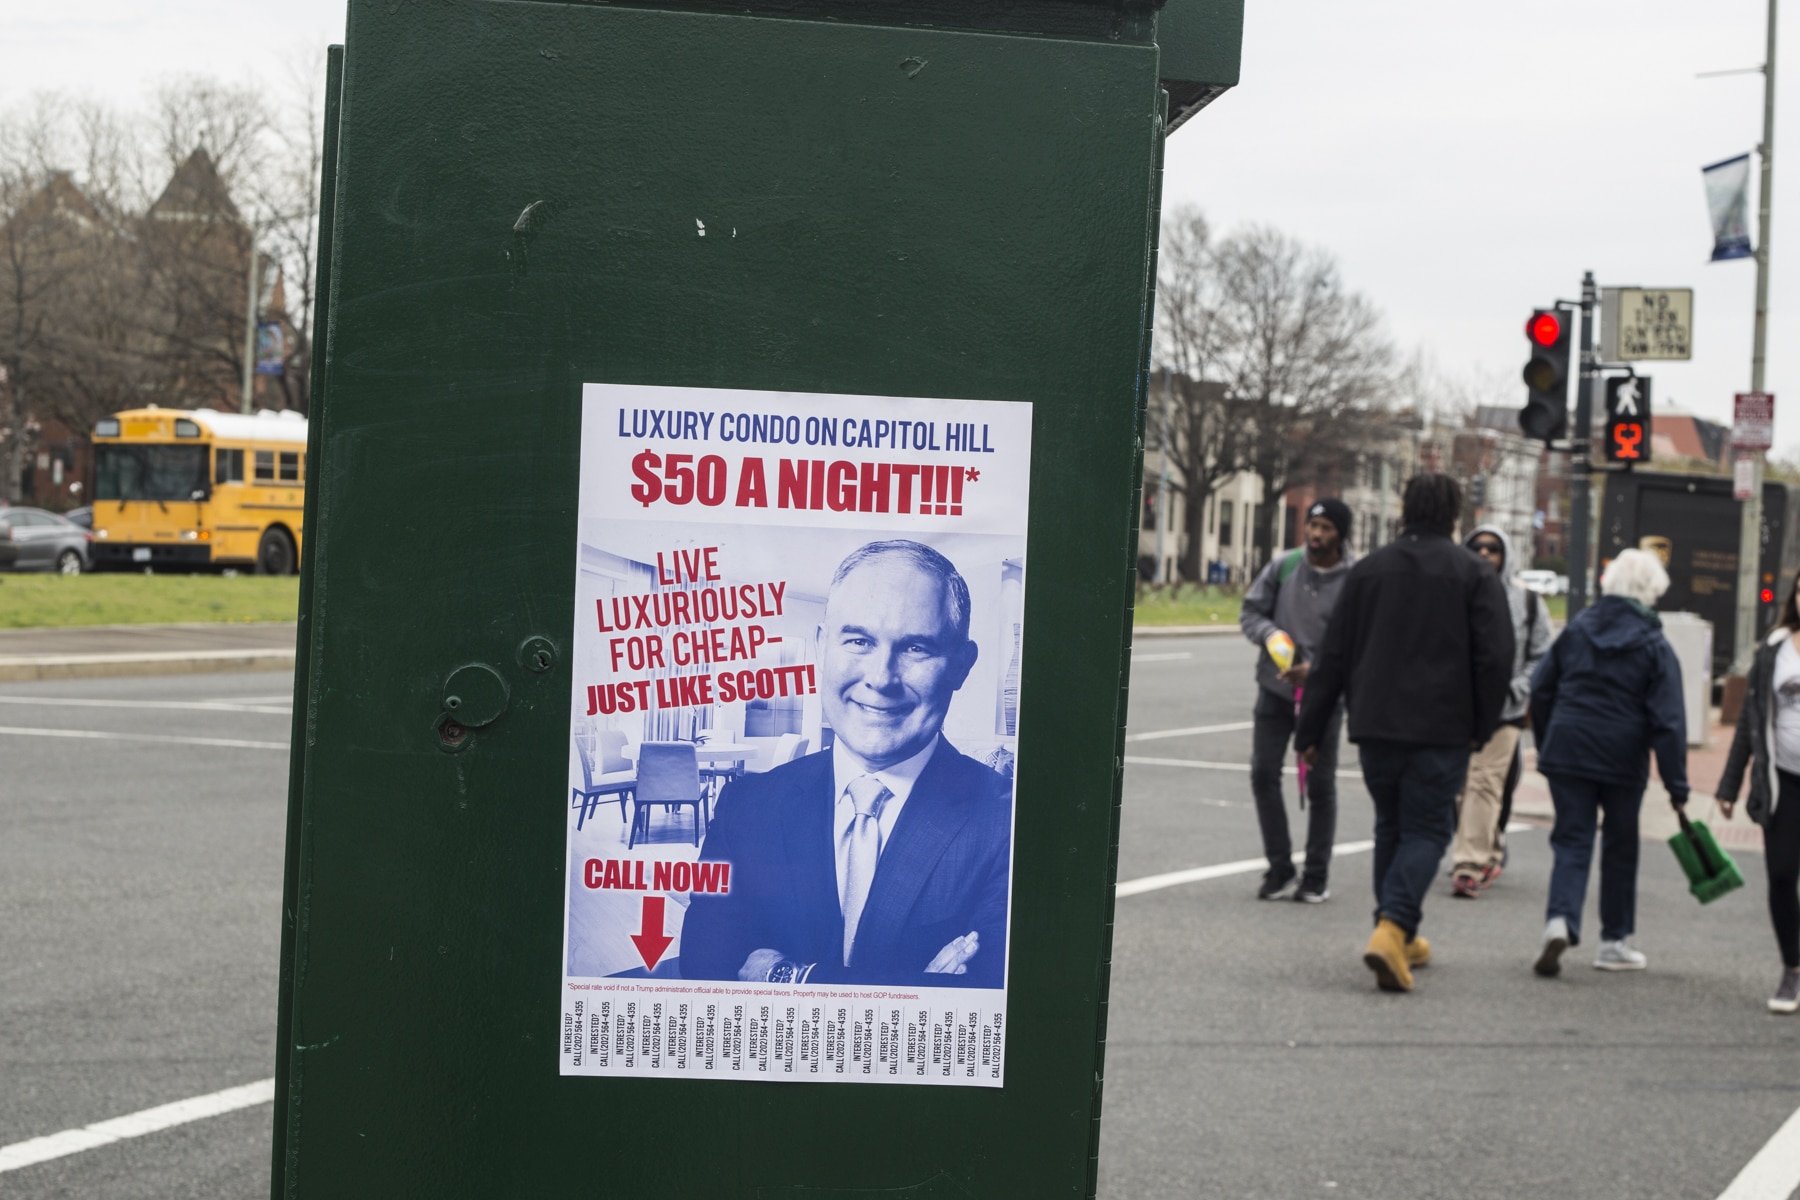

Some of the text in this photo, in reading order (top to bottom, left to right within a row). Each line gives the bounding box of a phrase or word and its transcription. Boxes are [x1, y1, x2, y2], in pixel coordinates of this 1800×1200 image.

[1643, 293, 1669, 308] NO
[619, 409, 994, 452] LUXURY CONDO ON CAPITOL HILL
[632, 449, 726, 507] $50
[736, 458, 768, 507] A
[658, 548, 720, 585] LIVE
[597, 582, 784, 632] LUXURIOUSLY
[610, 636, 664, 672] FOR
[588, 664, 816, 715] JUST LIKE SCOTT!
[585, 859, 729, 892] CALL NOW!
[636, 985, 654, 993] Trump
[732, 988, 752, 996] provide
[793, 990, 816, 998] Property
[564, 1013, 572, 1053] INTERESTED?
[591, 1014, 599, 1054] INTERESTED?
[616, 1015, 624, 1054] INTERESTED?
[642, 1016, 650, 1055] INTERESTED?
[668, 1016, 676, 1056] INTERESTED?
[696, 1017, 704, 1057] INTERESTED?
[723, 1018, 731, 1057] INTERESTED?
[750, 1018, 758, 1058] INTERESTED?
[775, 1020, 784, 1059] INTERESTED?
[801, 1020, 809, 1060] INTERESTED?
[827, 1021, 835, 1060] INTERESTED?
[854, 1022, 862, 1061] INTERESTED?
[880, 1022, 888, 1062] INTERESTED?
[908, 1023, 916, 1062] INTERESTED?
[934, 1024, 942, 1063] INTERESTED?
[958, 1024, 966, 1064] INTERESTED?
[983, 1025, 991, 1065] INTERESTED?
